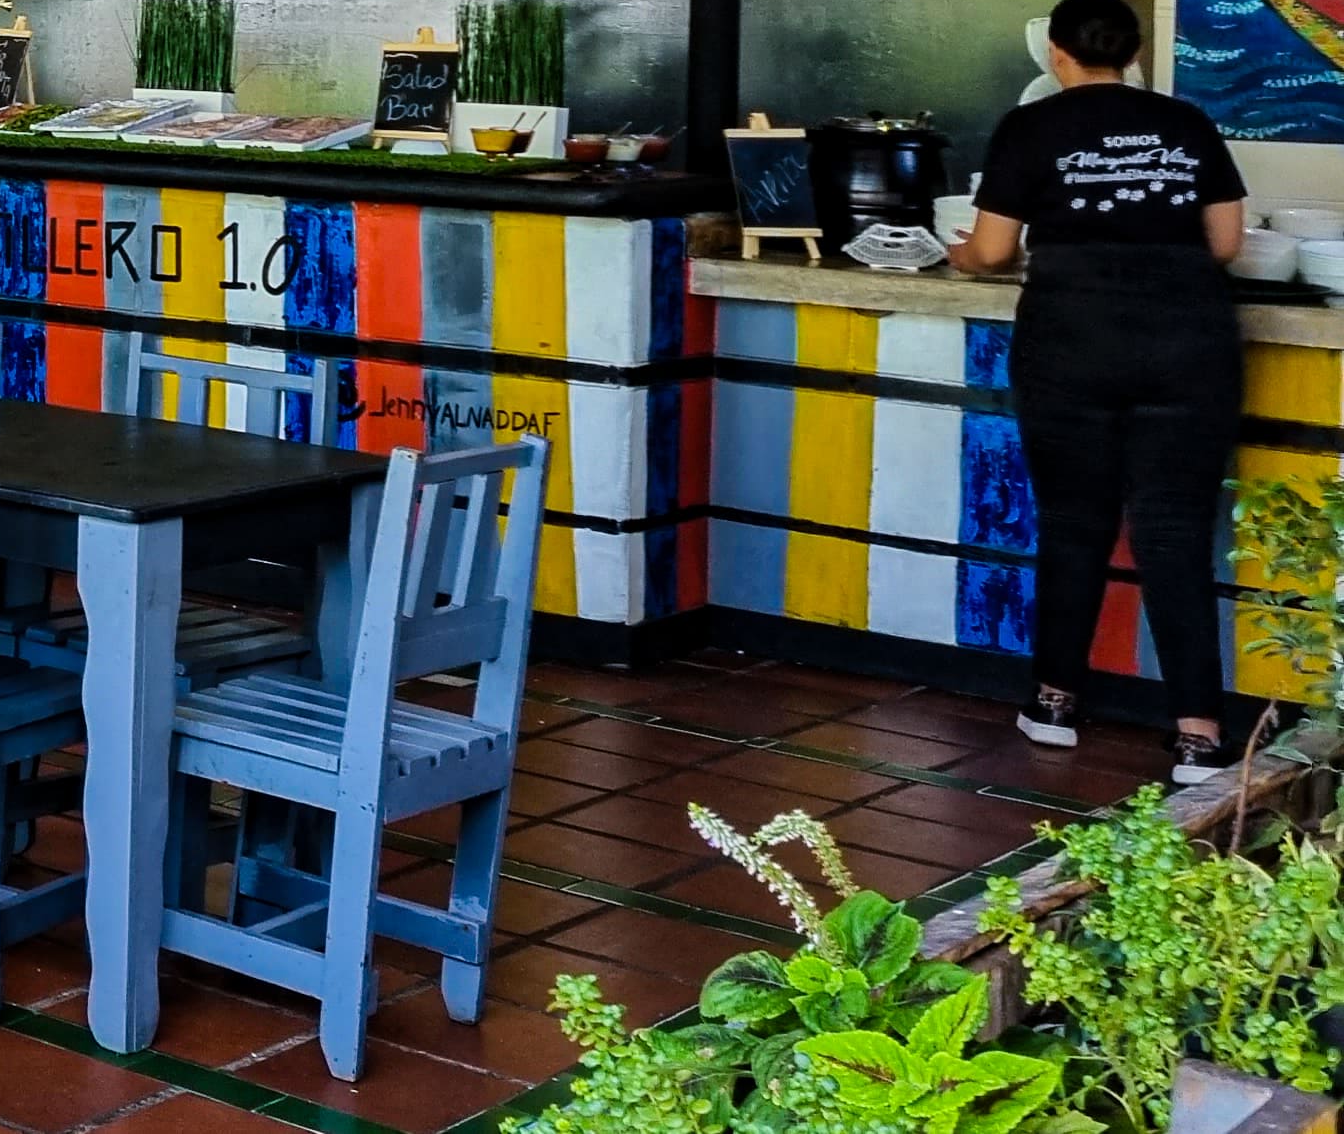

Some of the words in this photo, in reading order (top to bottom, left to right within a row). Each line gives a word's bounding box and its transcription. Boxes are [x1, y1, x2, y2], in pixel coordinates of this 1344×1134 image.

[385, 63, 449, 90] Salad
[381, 94, 434, 122] Bar
[1102, 134, 1162, 148] SOMOS
[216, 221, 304, 297] 1.0
